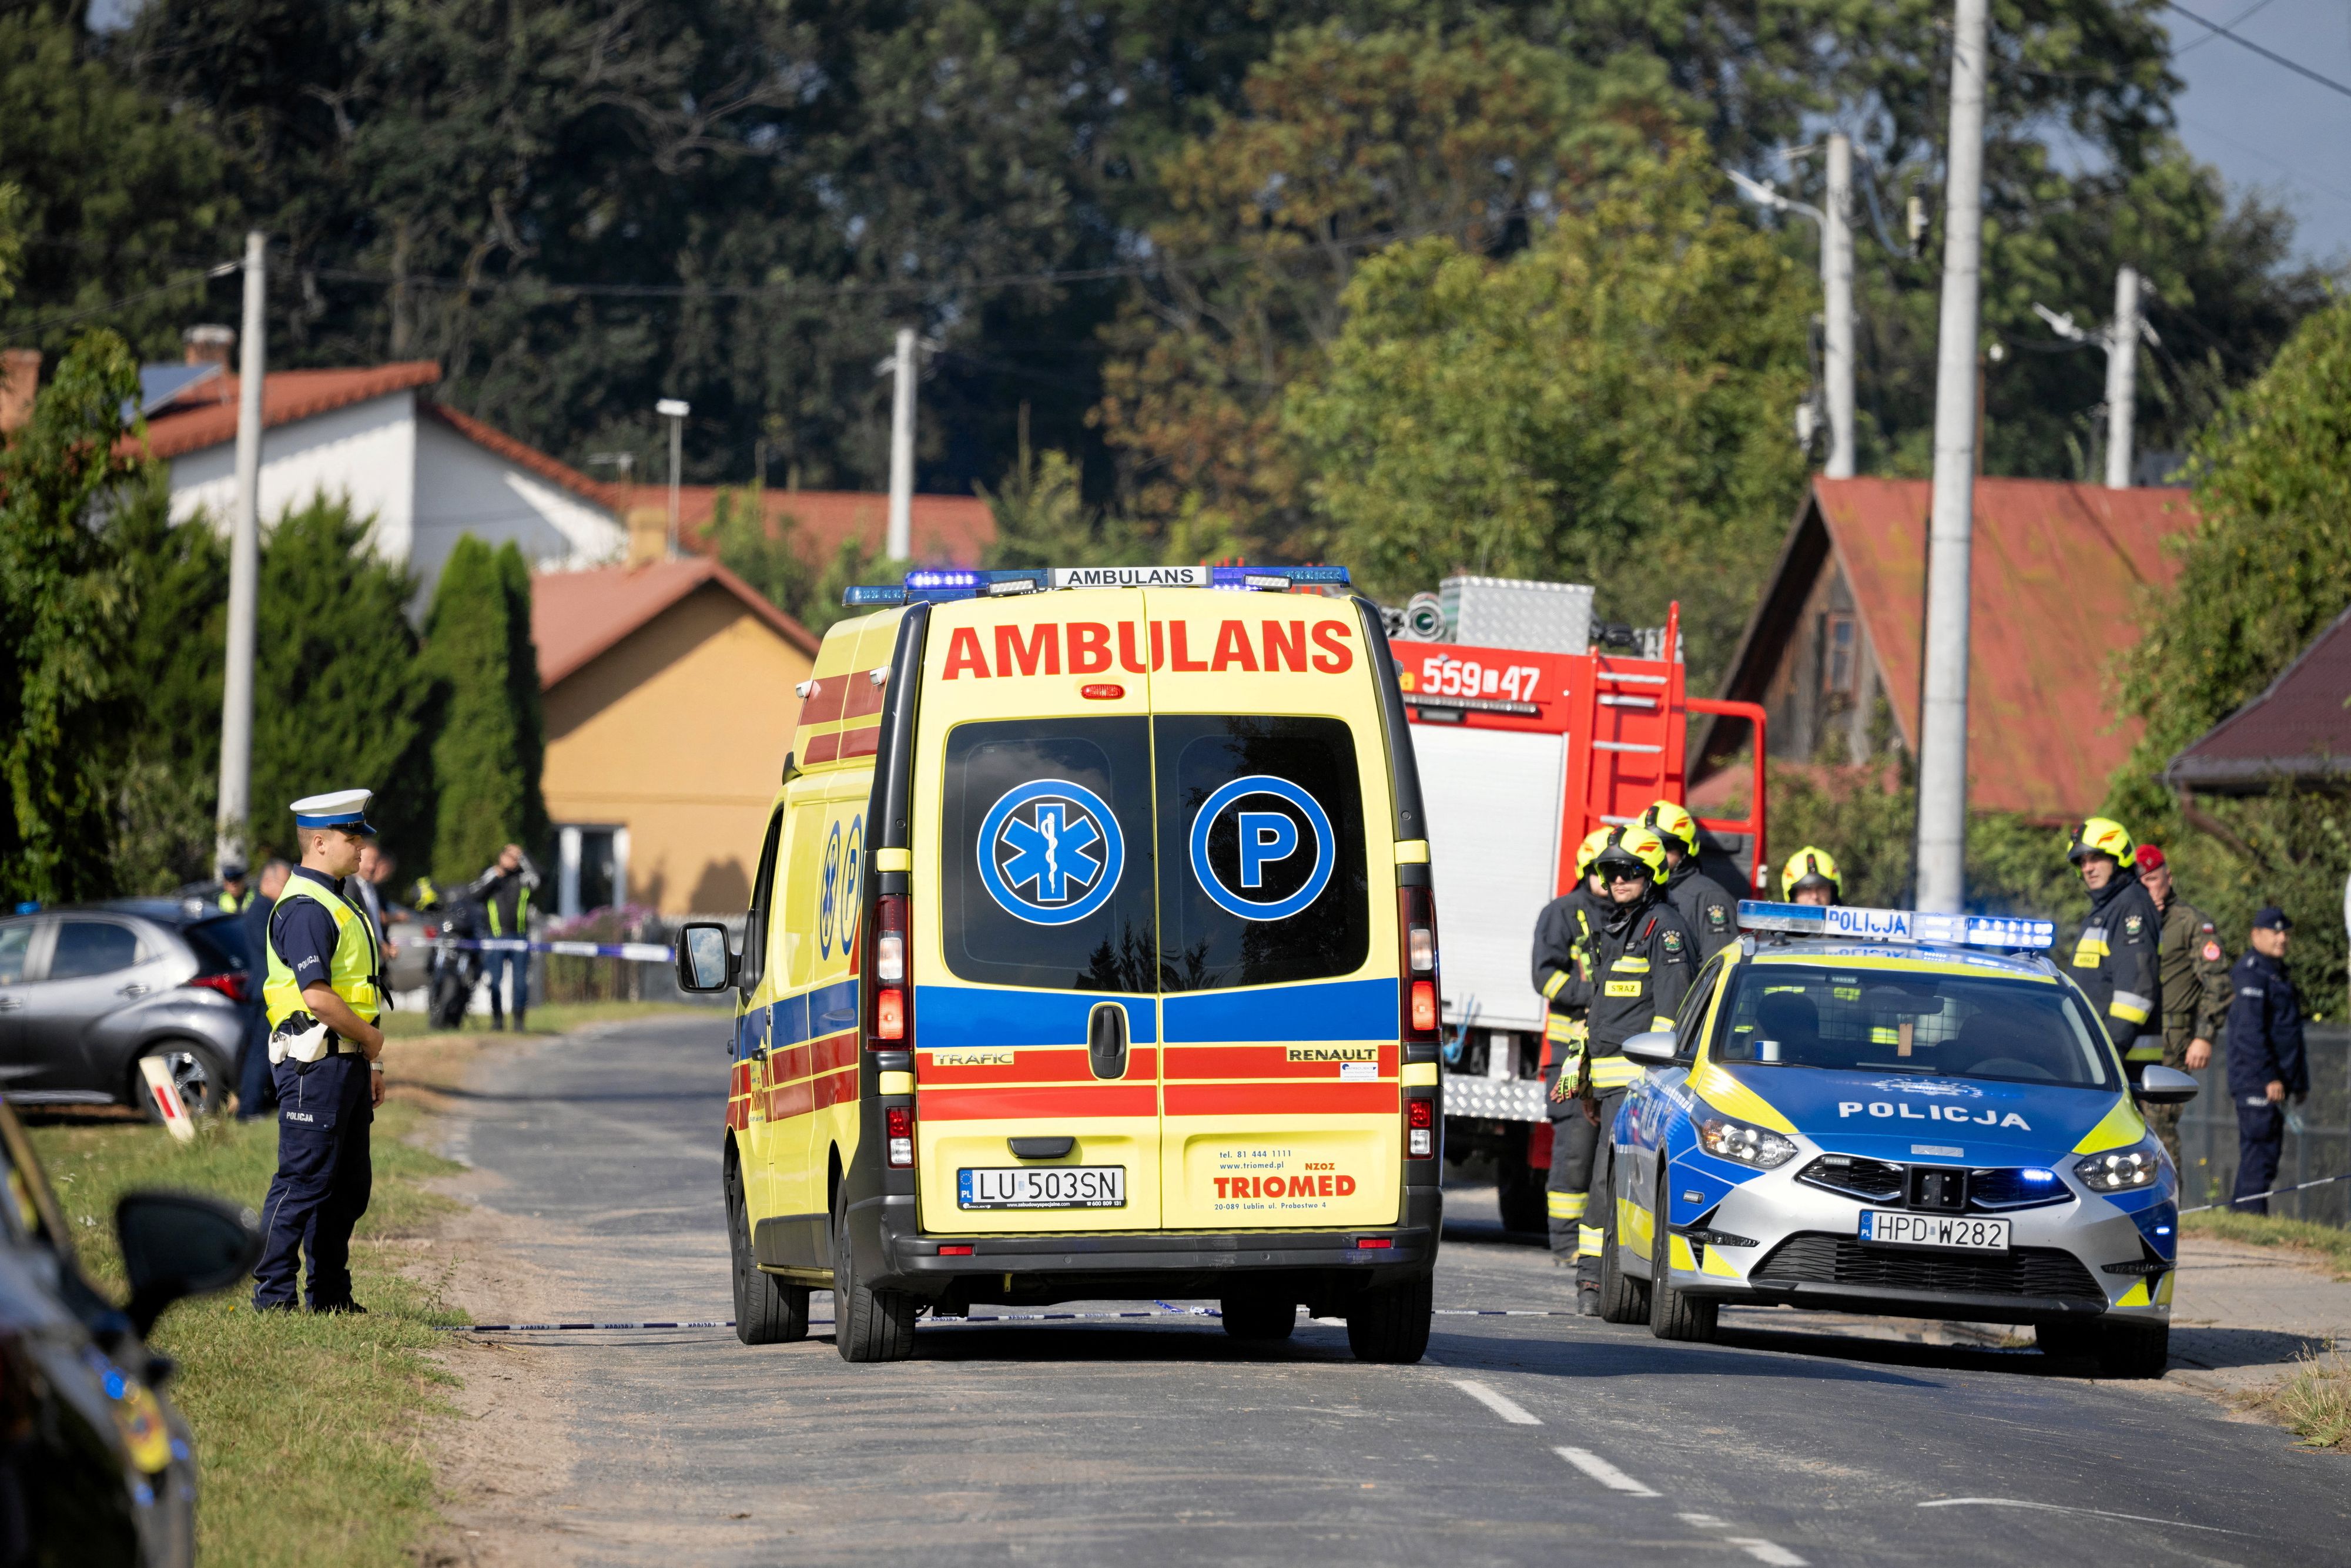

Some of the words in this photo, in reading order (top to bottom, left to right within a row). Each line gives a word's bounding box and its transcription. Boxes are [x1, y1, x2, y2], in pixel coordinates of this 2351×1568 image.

[1067, 568, 1194, 585] AMBULANS
[942, 619, 1353, 680] AMBULANS
[1422, 658, 1481, 697] 559
[1500, 665, 1540, 702] 47
[1238, 812, 1298, 887] P
[297, 955, 320, 971] POLICJA
[936, 1053, 1012, 1065] TRAFIC
[1290, 1049, 1376, 1061] RENAULT
[286, 1111, 313, 1123] POLICJA
[1838, 1102, 2031, 1131] POLICJA
[1220, 1161, 1284, 1170] www.triomed.pl
[980, 1173, 1015, 1200] LU
[1029, 1172, 1115, 1199] 503SN
[1214, 1175, 1356, 1198] TRIOMED
[1878, 1215, 1927, 1241] HPD
[1940, 1220, 2001, 1247] W282
